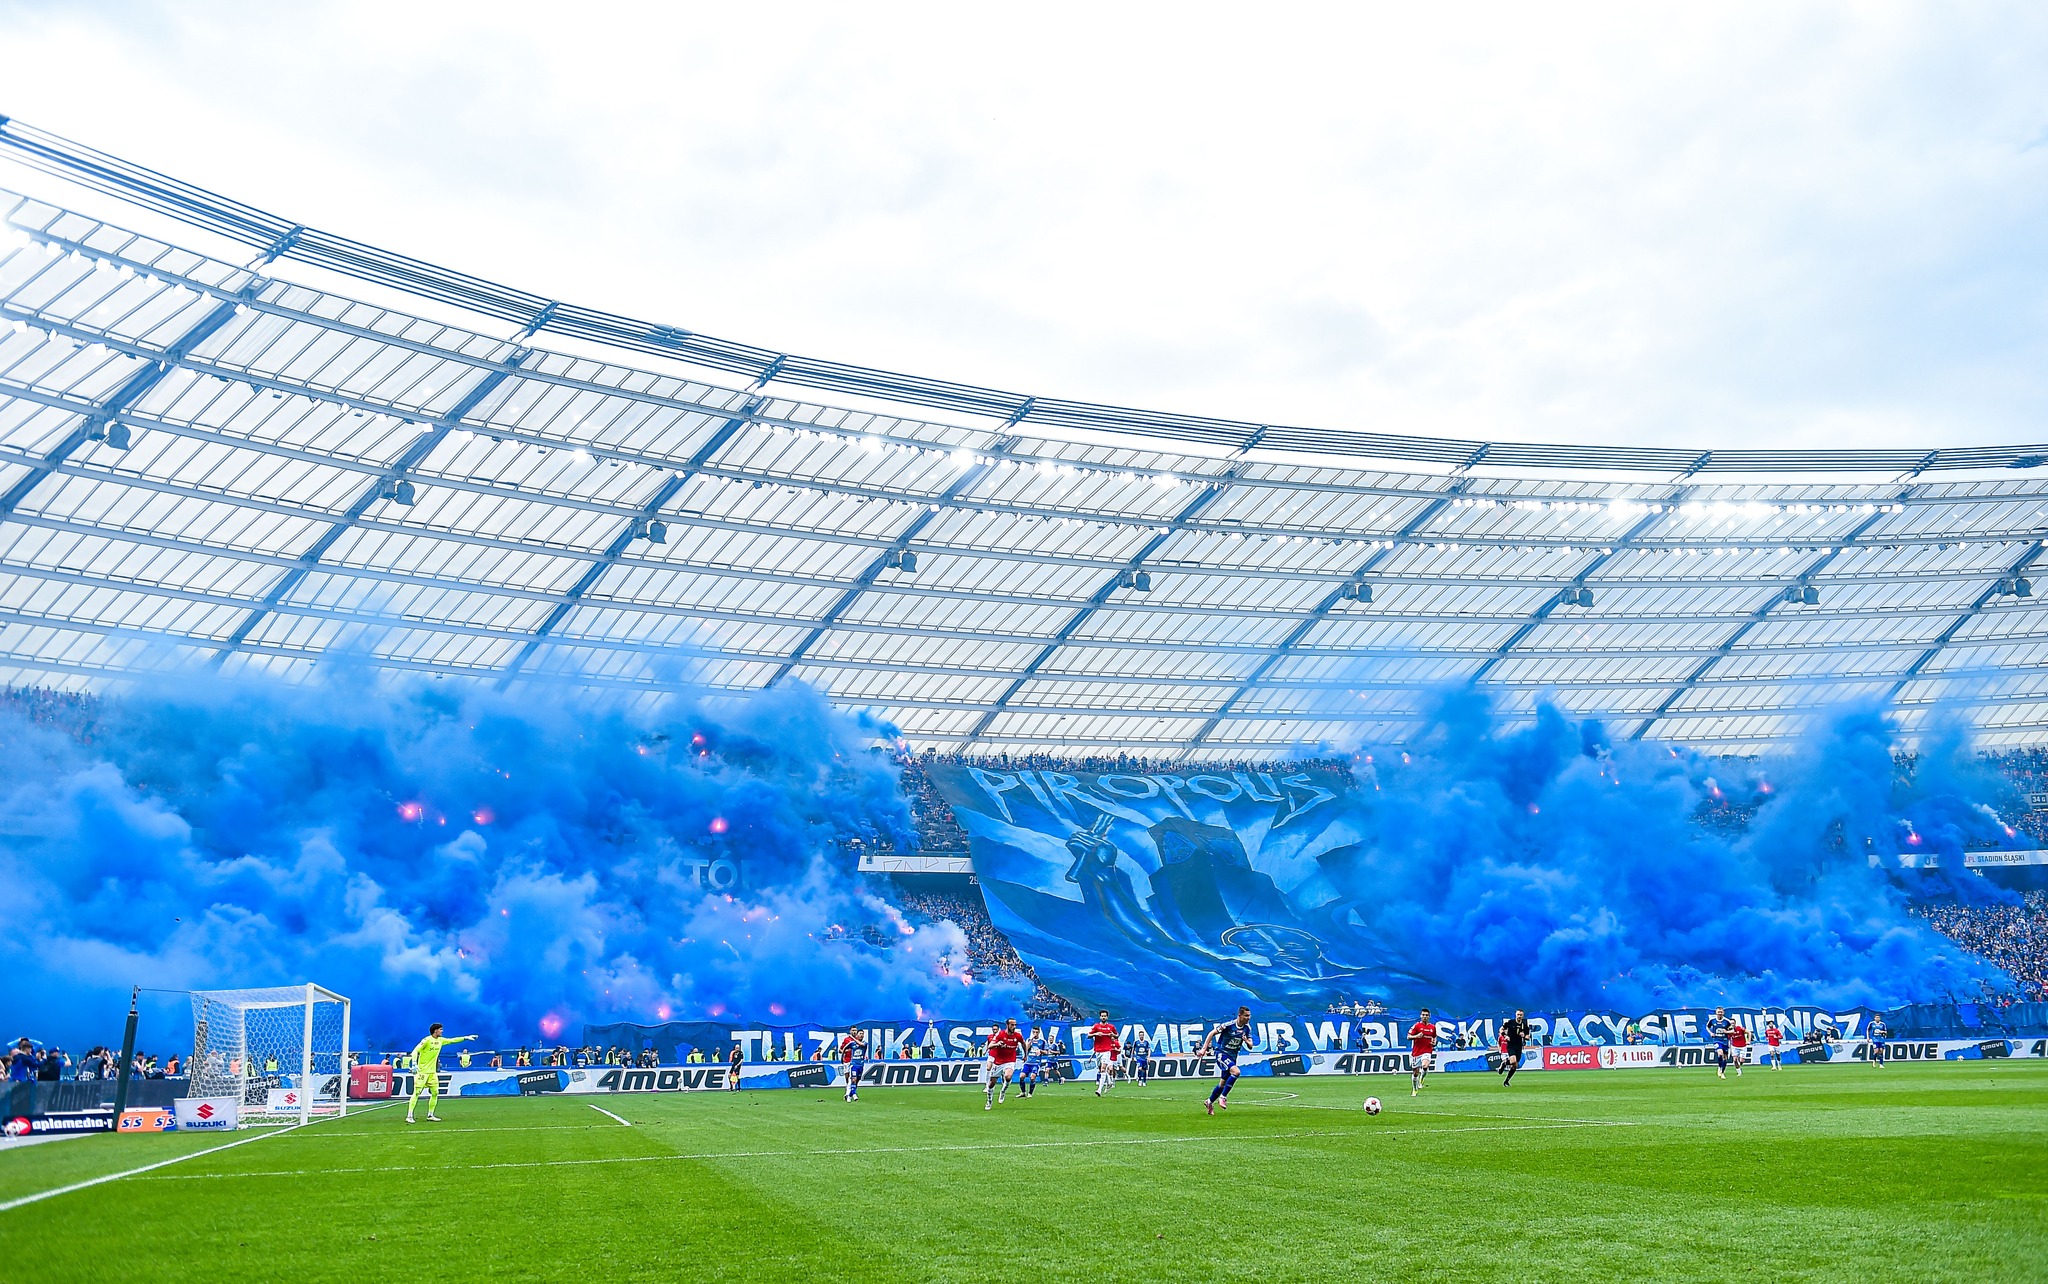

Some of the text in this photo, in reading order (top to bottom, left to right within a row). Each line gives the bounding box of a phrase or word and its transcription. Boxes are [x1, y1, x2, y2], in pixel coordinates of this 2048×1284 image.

[966, 766, 1338, 829] PIROPOLIS
[1977, 855, 2003, 863] STADION
[2004, 853, 2025, 864] ŚLĄSKI
[731, 1031, 794, 1062] TU
[1304, 1021, 1352, 1051] W
[1362, 1018, 1511, 1051] BLSKU
[1527, 1013, 1631, 1047] RACY
[1549, 1051, 1592, 1067] Betclic
[1622, 1051, 1654, 1062] 1 LIGA
[1659, 1046, 1753, 1066] 4MOE
[121, 1115, 144, 1129] STS
[154, 1114, 176, 1128] STS
[185, 1120, 227, 1128] SUZUKI
